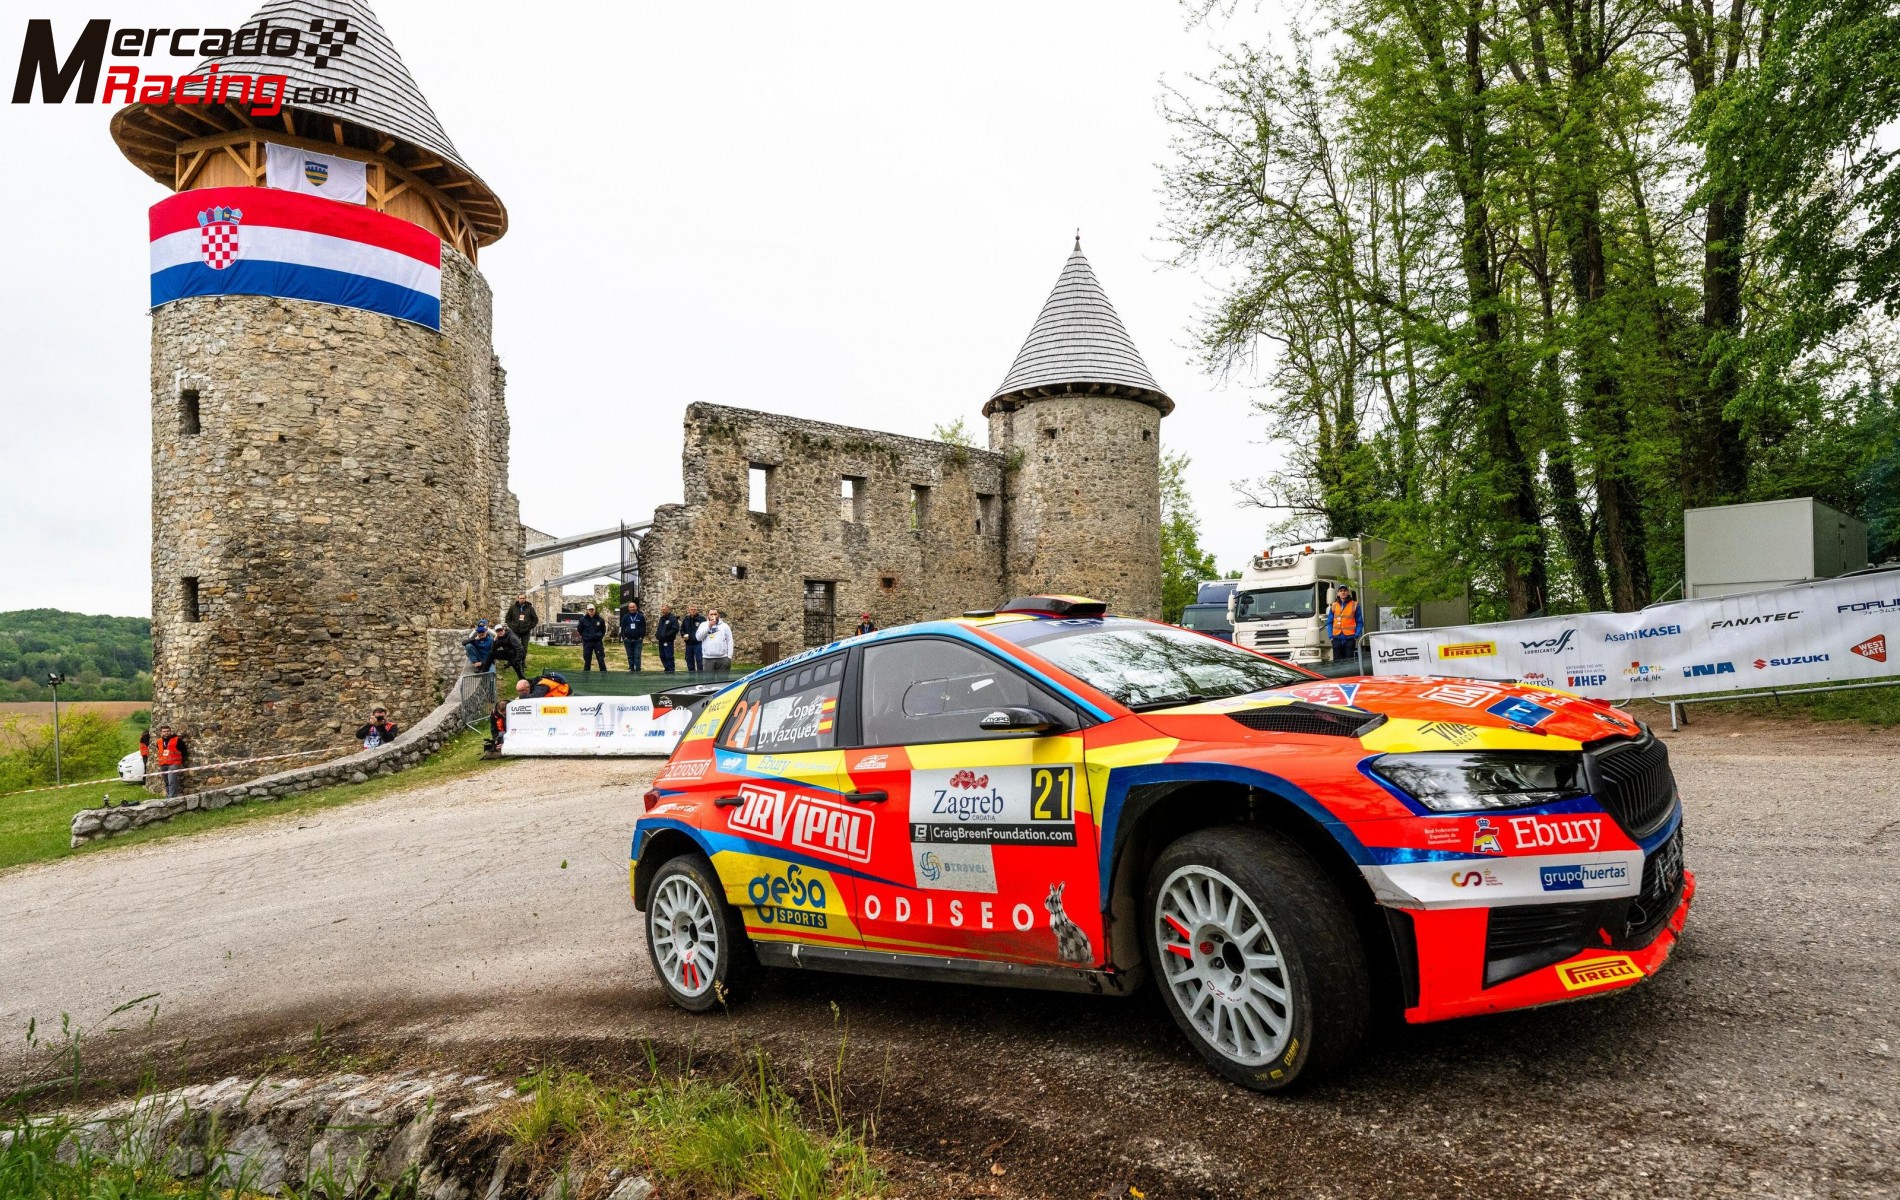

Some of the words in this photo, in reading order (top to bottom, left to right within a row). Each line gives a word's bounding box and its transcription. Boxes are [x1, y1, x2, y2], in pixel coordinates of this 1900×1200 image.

[1711, 611, 1802, 629] FANATEC
[1378, 647, 1419, 657] WRC
[1443, 644, 1492, 657] PIRELLI
[1859, 640, 1884, 650] WEST
[1862, 646, 1886, 656] GATE
[1770, 653, 1829, 667] SUZUKI
[1581, 674, 1607, 686] HEP
[725, 700, 761, 749] 21
[757, 755, 791, 775] Ebury
[1034, 769, 1070, 819] 21
[932, 787, 1004, 821] Zagreb
[733, 789, 866, 857] ORVIPAL
[972, 814, 996, 822] CROATIA
[933, 827, 1073, 842] CraigBreenFoundation.com
[1508, 816, 1602, 850] Ebury
[779, 910, 825, 928] SPORTS
[864, 894, 1034, 931] ODISEO
[1564, 959, 1635, 985] PIRELLI
